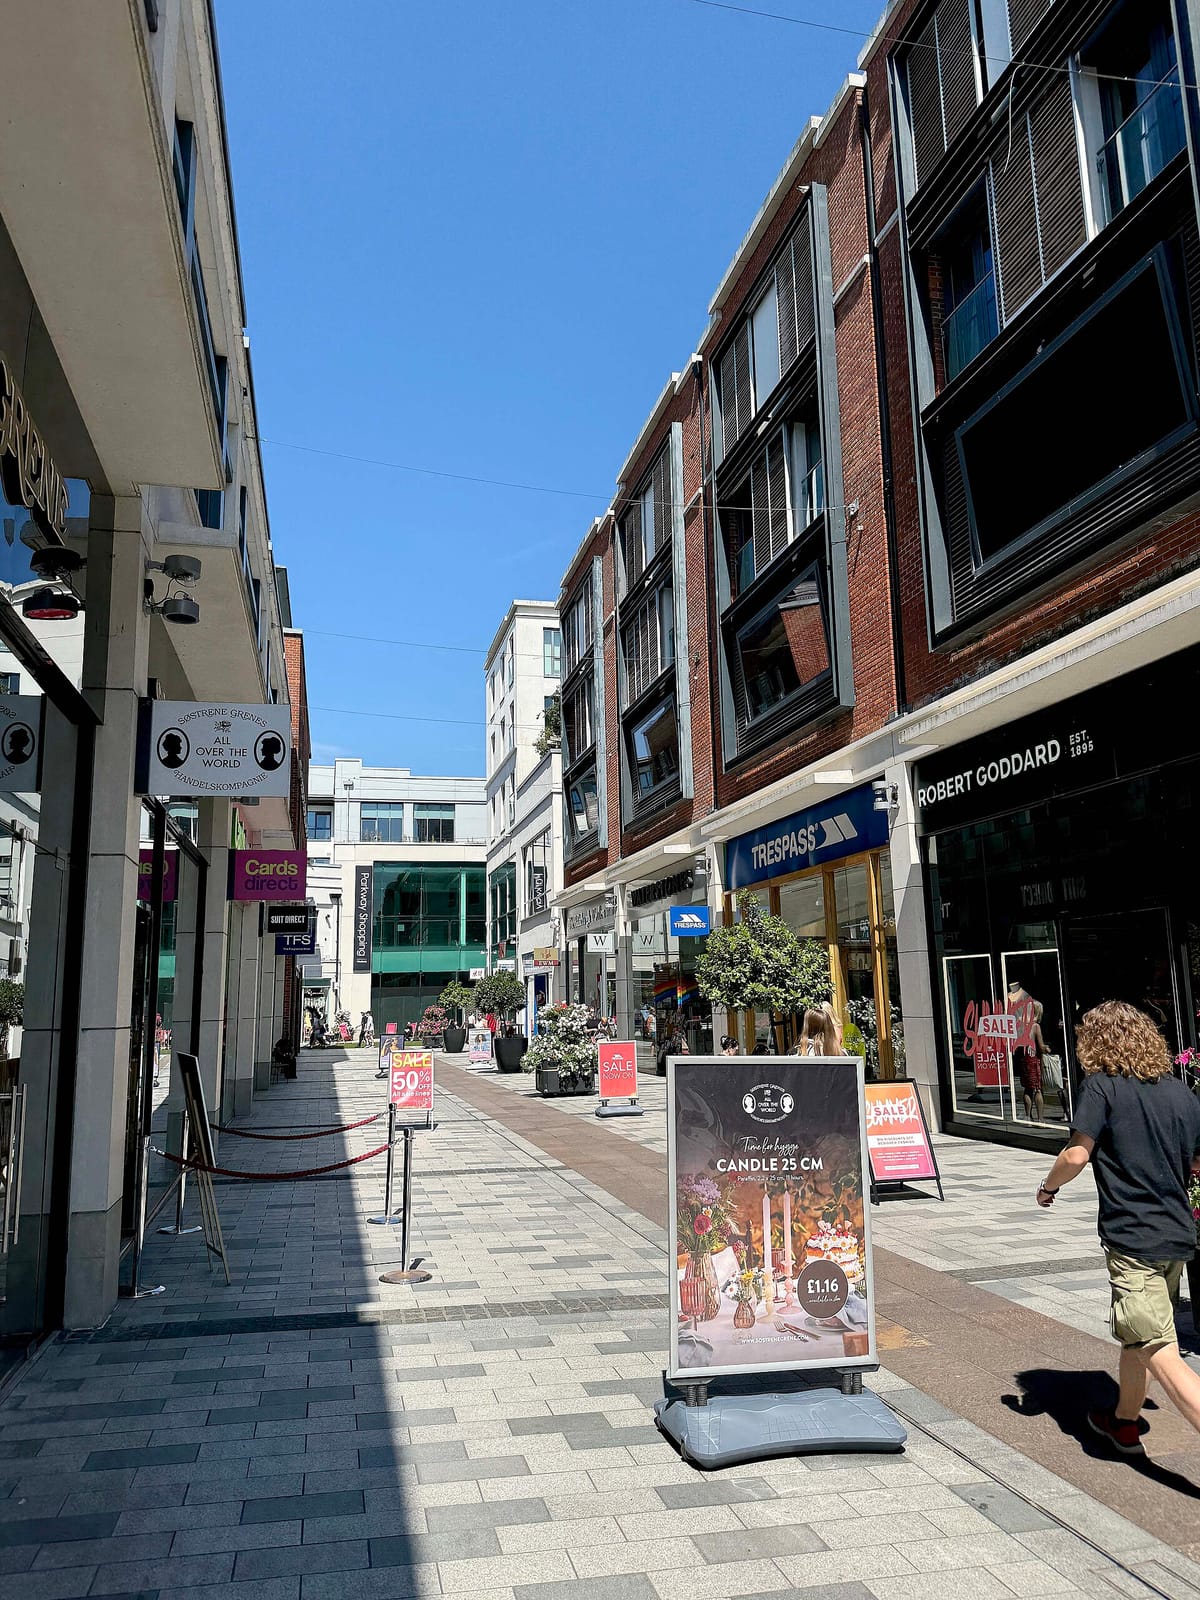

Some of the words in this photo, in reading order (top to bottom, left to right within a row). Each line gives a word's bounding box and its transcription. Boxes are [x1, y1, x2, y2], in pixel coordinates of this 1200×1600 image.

[177, 708, 228, 725] SØSTRENE
[230, 709, 268, 728] GRENES
[213, 736, 231, 745] ALL
[1069, 730, 1090, 745] EST.
[195, 747, 224, 756] OVER
[229, 748, 248, 757] THE
[1070, 740, 1094, 758] 1895
[202, 759, 241, 768] WORLD
[173, 770, 268, 791] HANDELSKOMPAGNIE
[917, 770, 973, 808] ROBERT
[976, 739, 1061, 787] GODDARD
[751, 824, 816, 870] TRESPASS
[245, 859, 298, 876] Cards
[244, 876, 298, 891] direct
[358, 872, 370, 911] Parkway
[270, 915, 284, 924] SUIT
[285, 915, 305, 924] DIRECT
[283, 934, 311, 945] TFS
[356, 913, 369, 957] Shopping
[592, 935, 607, 946] W
[983, 1018, 1014, 1034] SALE
[392, 1053, 432, 1069] SALE
[603, 1060, 633, 1072] SALE
[874, 1106, 905, 1117] SALE
[740, 1136, 761, 1152] Time
[761, 1136, 773, 1153] for
[773, 1137, 800, 1156] hygge
[716, 1158, 778, 1172] CANDLE
[781, 1158, 797, 1171] 25
[800, 1157, 824, 1171] CM
[807, 1278, 839, 1293] £1.16
